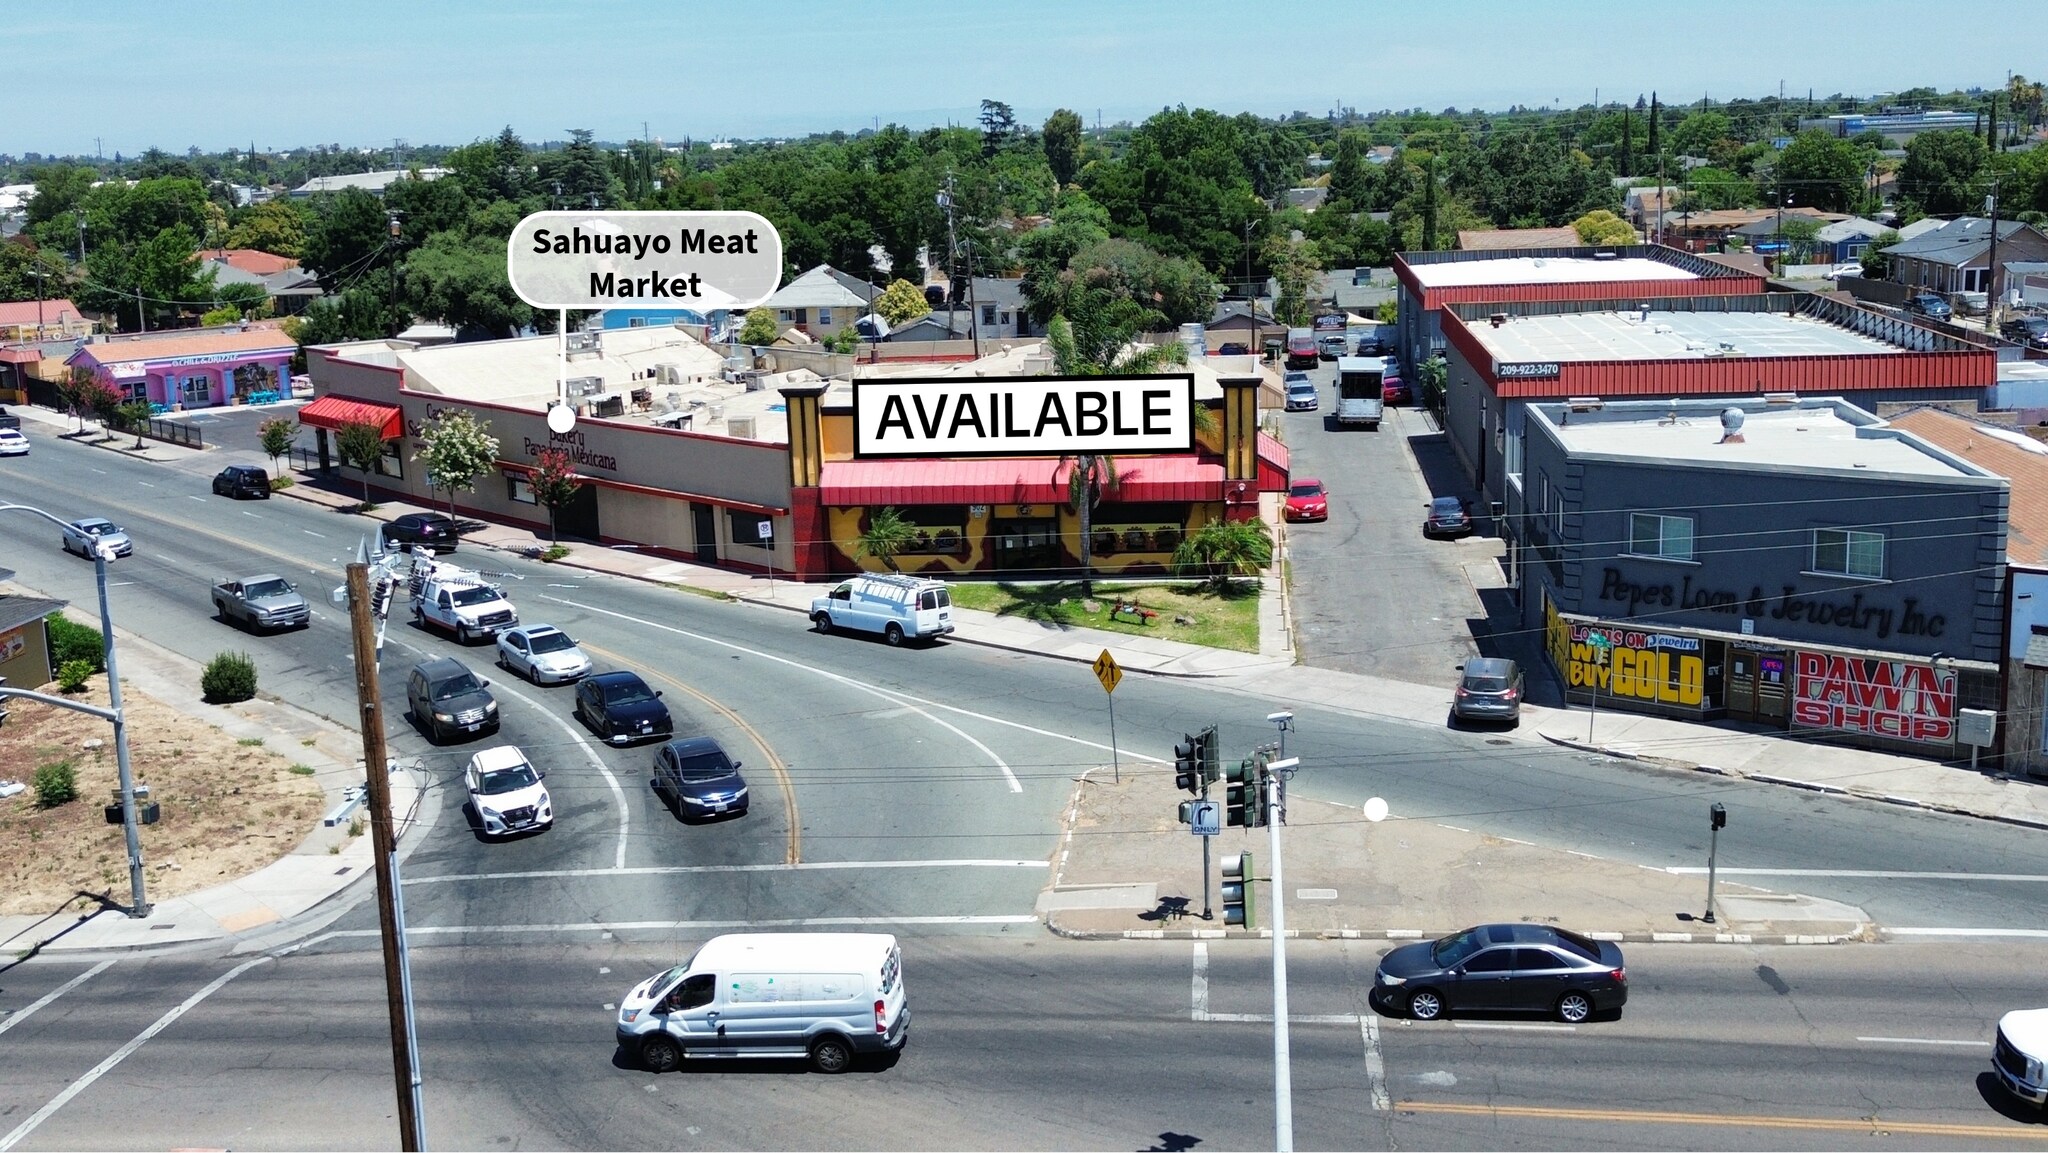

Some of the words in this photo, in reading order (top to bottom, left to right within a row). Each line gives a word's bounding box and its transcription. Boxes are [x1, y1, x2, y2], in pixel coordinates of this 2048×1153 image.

[1500, 364, 1559, 375] 209-922-3470
[571, 445, 617, 471] Mexicana
[1599, 567, 1674, 617] Pepes
[1680, 574, 1739, 615] Loan
[1745, 586, 1766, 617] &
[1897, 597, 1946, 638] Inc
[1570, 642, 1609, 664] WE
[1625, 632, 1647, 649] ON
[1650, 635, 1698, 650] Jewelry
[1569, 660, 1611, 689] BUY
[1613, 647, 1703, 705] GOLD
[1796, 651, 1955, 719] PAWN
[1795, 700, 1953, 741] SHOP
